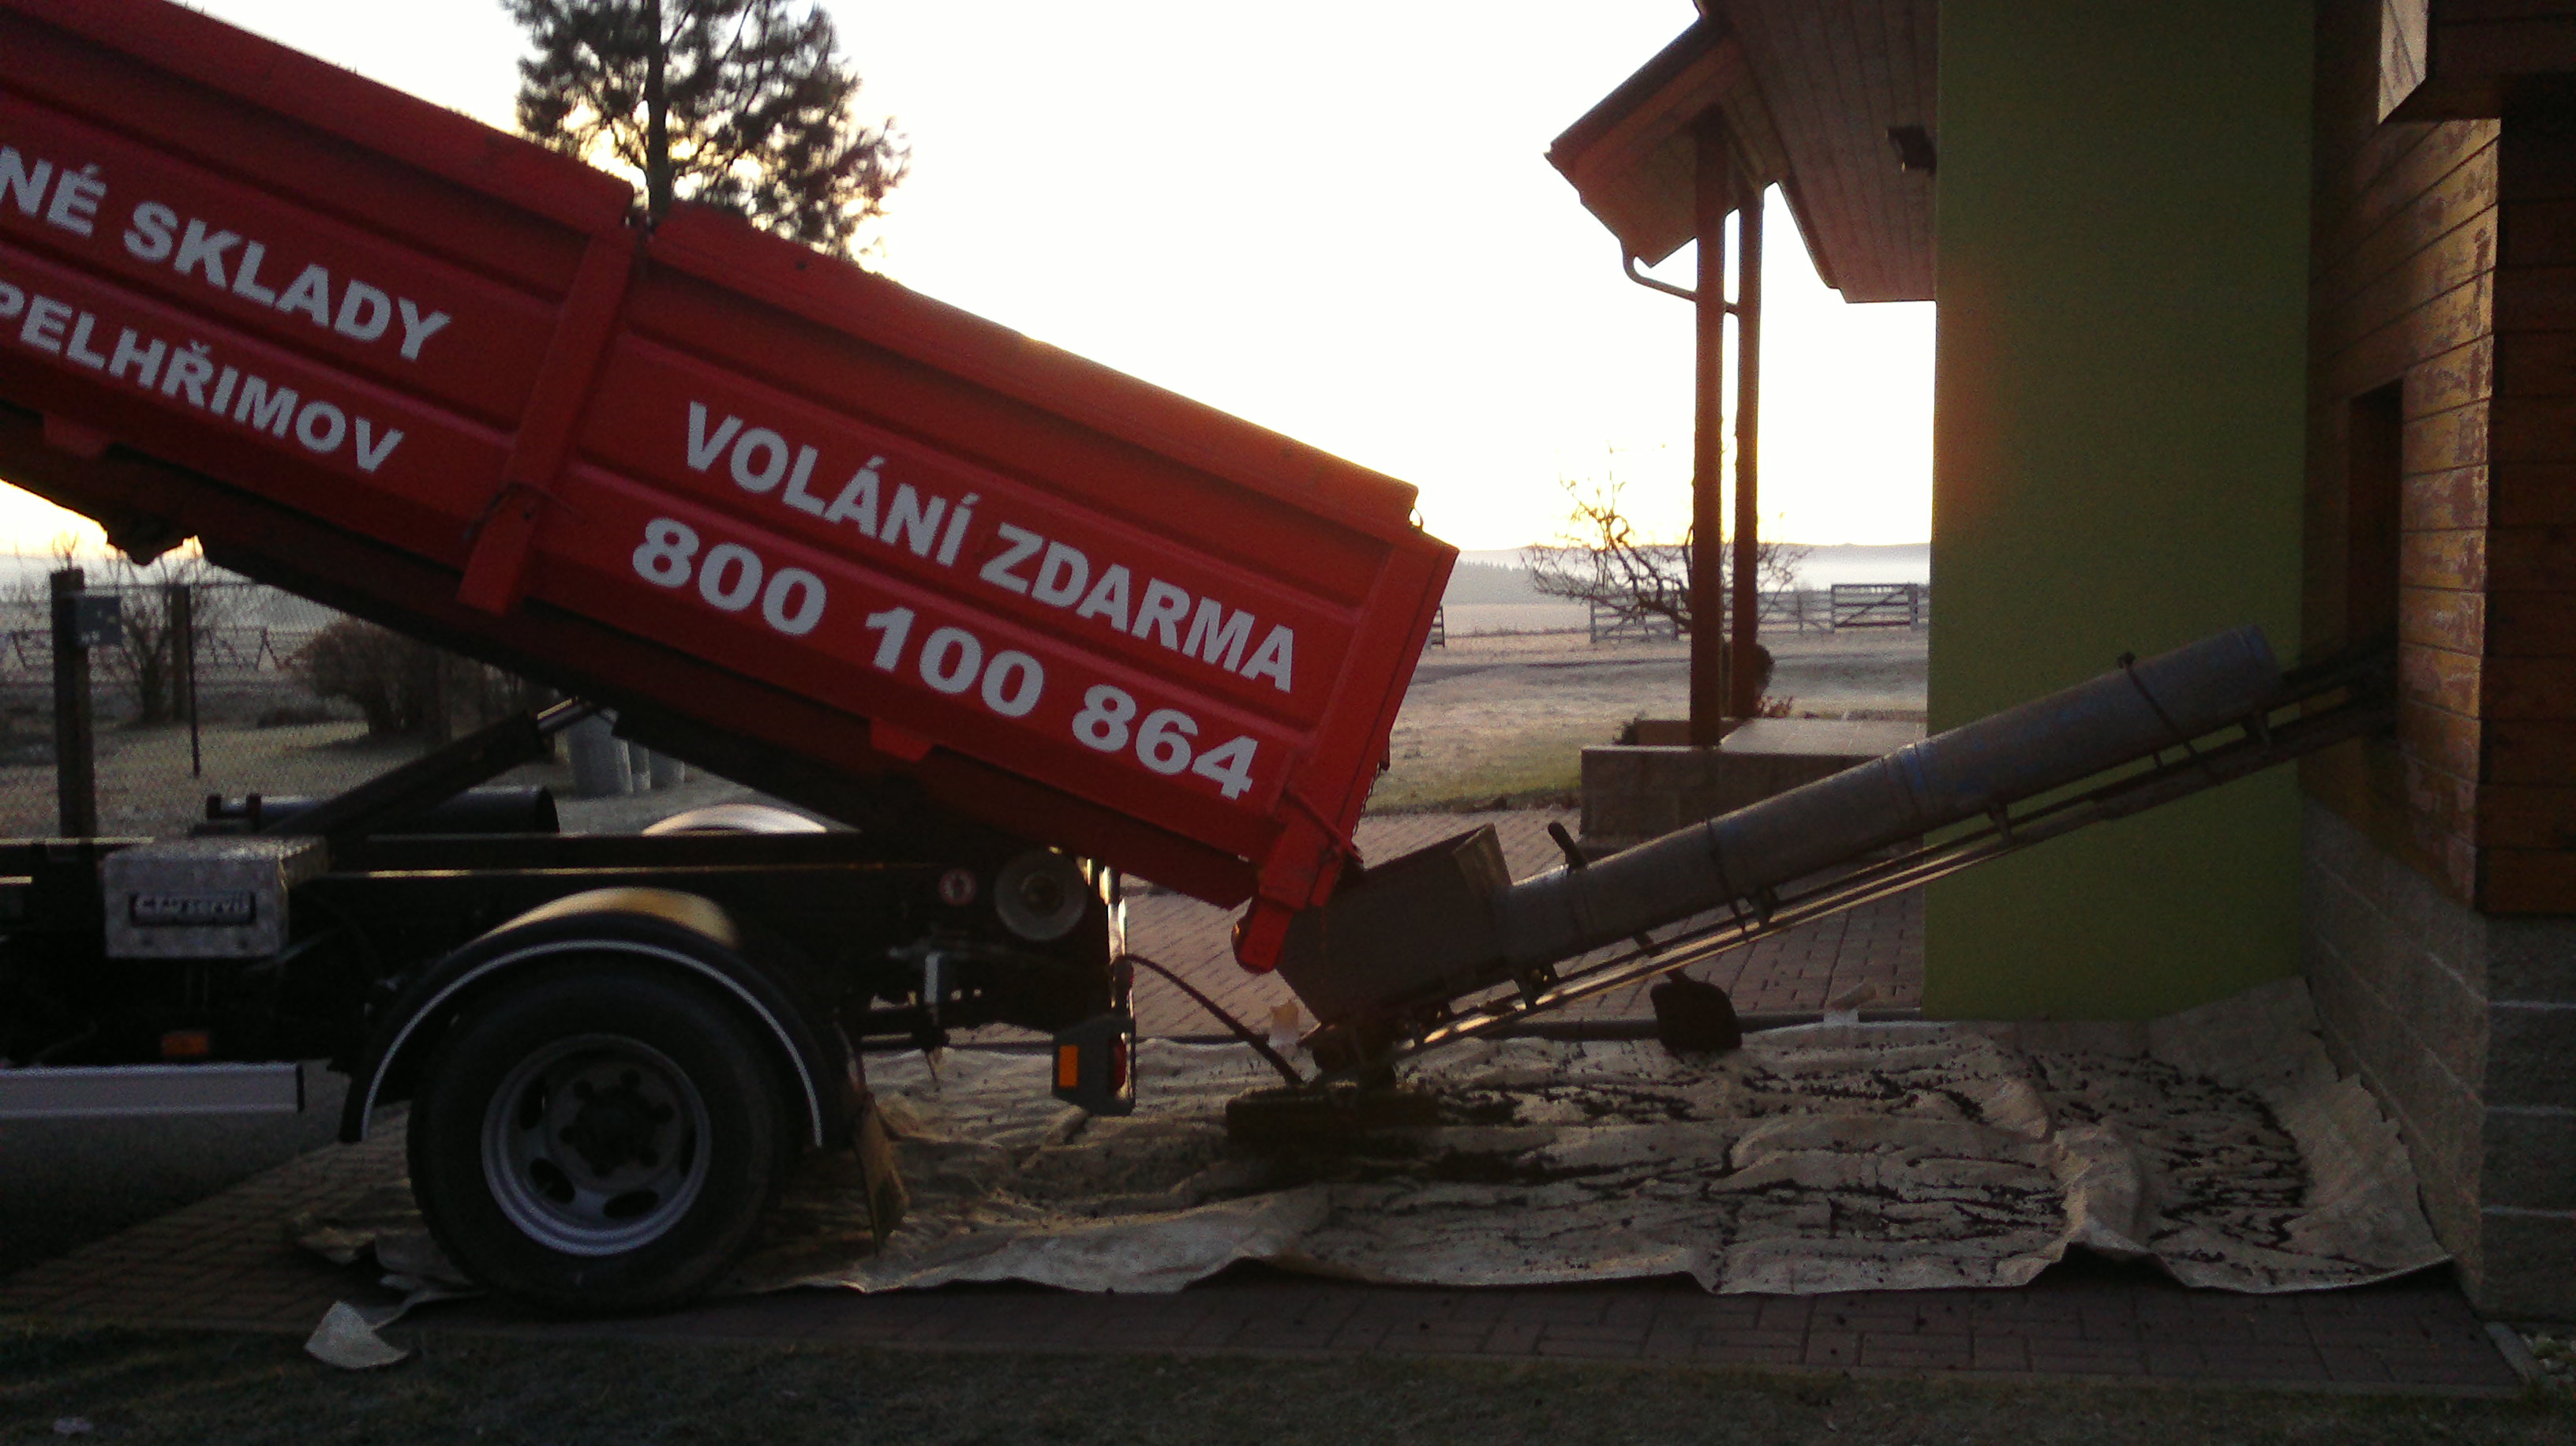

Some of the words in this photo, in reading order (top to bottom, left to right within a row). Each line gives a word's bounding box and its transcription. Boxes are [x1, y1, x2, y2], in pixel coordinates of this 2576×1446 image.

[0, 144, 107, 236] NÉ
[124, 203, 451, 362] SKLADY
[632, 517, 827, 637] 800
[866, 607, 1044, 717] 100
[1072, 684, 1258, 800] 864
[686, 401, 978, 567] VOLÁNÍ
[979, 523, 1295, 693] ZDARMA
